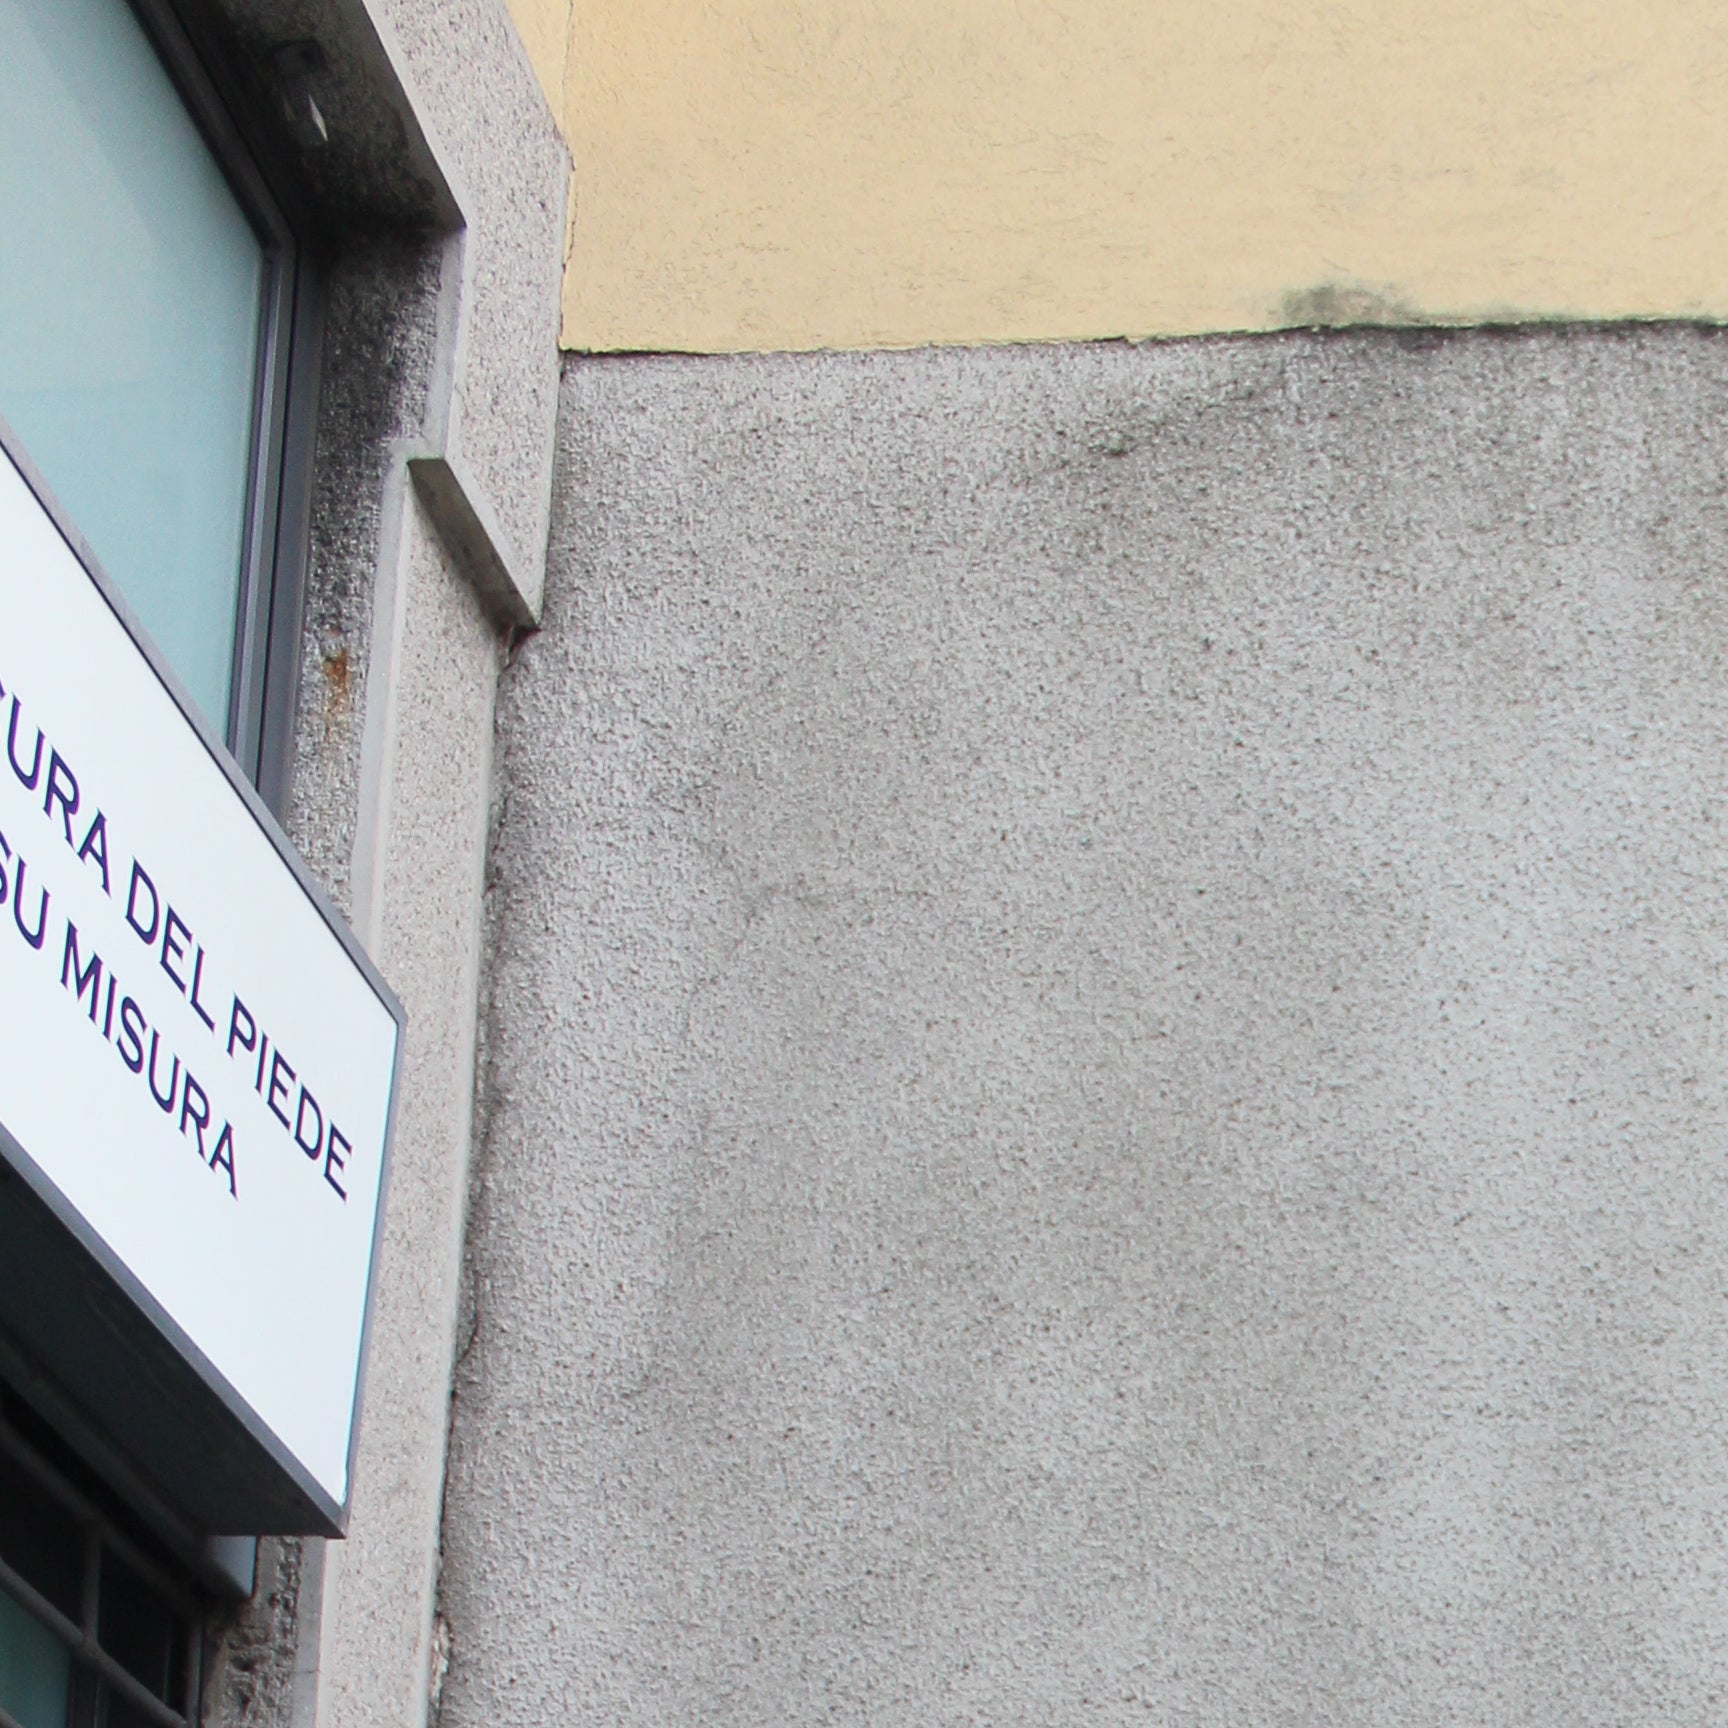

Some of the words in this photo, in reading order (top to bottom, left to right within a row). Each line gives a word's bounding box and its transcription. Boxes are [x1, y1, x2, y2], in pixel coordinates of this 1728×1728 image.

[0, 678, 111, 898] URA
[125, 857, 216, 1033] DEL
[226, 994, 353, 1202] PIEDE
[61, 917, 238, 1199] MISURA
